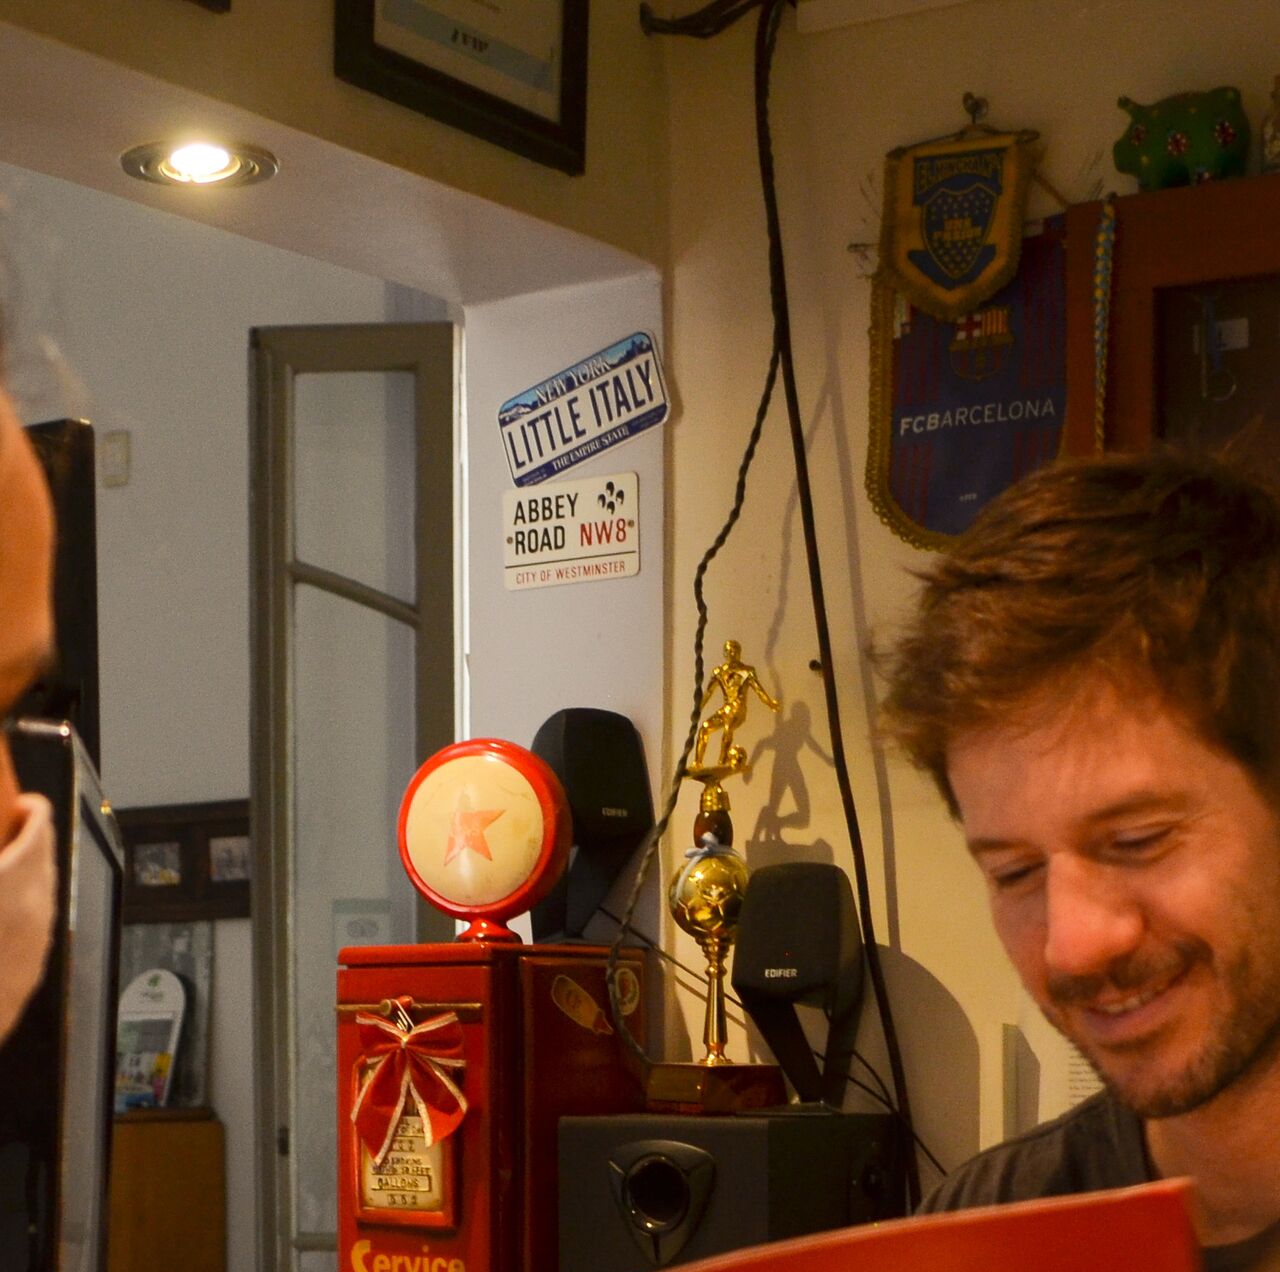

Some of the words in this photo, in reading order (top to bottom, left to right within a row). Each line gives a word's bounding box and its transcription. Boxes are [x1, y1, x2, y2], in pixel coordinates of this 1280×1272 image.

[534, 376, 567, 408] NEW
[569, 356, 611, 386] YORK
[508, 396, 586, 470] LITTLE
[589, 359, 655, 428] ITALY
[899, 398, 1056, 437] FCBARCELONA
[552, 456, 570, 472] THE
[570, 441, 601, 464] EMPIRE
[601, 424, 630, 447] STATE
[514, 492, 578, 526] ABBEY
[515, 525, 566, 556] ROAD
[580, 518, 626, 547] NW8
[516, 571, 538, 584] CITY
[540, 570, 552, 582] OF
[556, 560, 625, 580] WESTMINSTER
[602, 807, 628, 818] EDIFIER
[765, 968, 798, 978] EDIFIER
